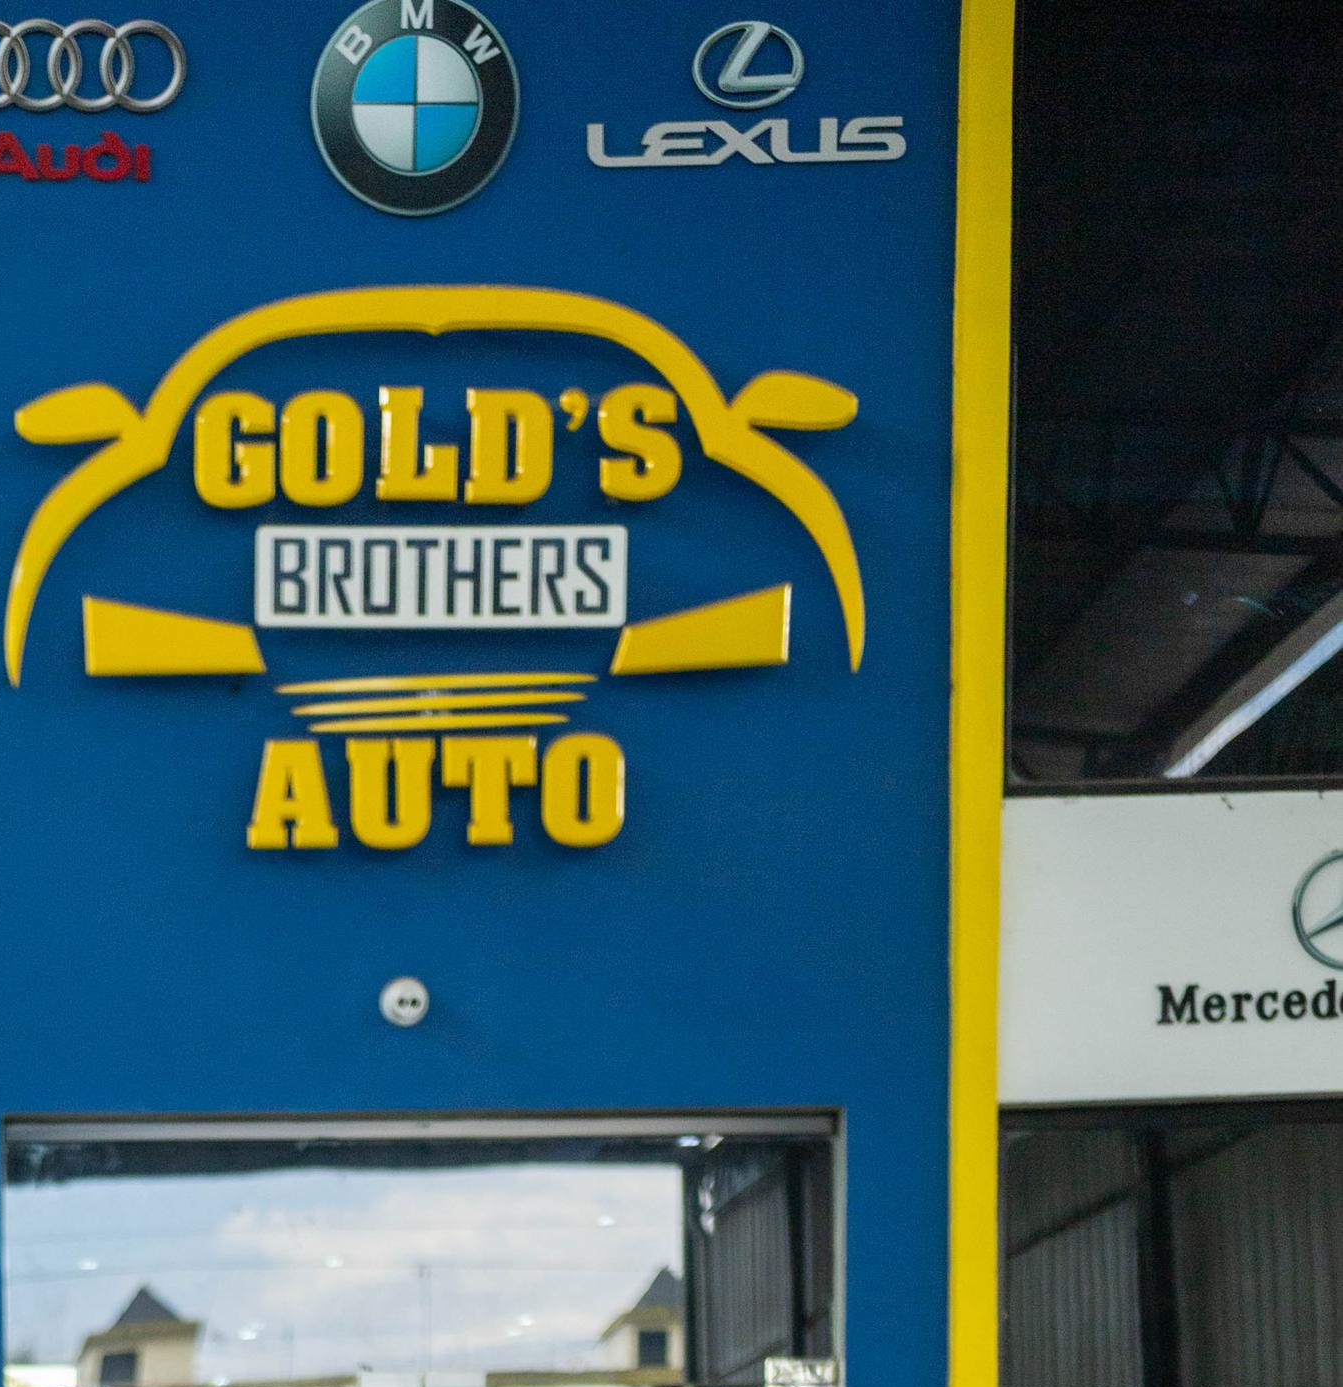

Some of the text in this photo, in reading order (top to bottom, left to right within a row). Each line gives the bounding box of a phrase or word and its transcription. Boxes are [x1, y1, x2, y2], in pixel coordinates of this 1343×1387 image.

[335, 0, 501, 65] BMW
[586, 116, 907, 168] LEXUS
[193, 384, 683, 509] GOLD'S
[271, 535, 613, 619] BROTHERS
[246, 732, 626, 850] AUTO
[1155, 979, 1343, 1025] Merced
